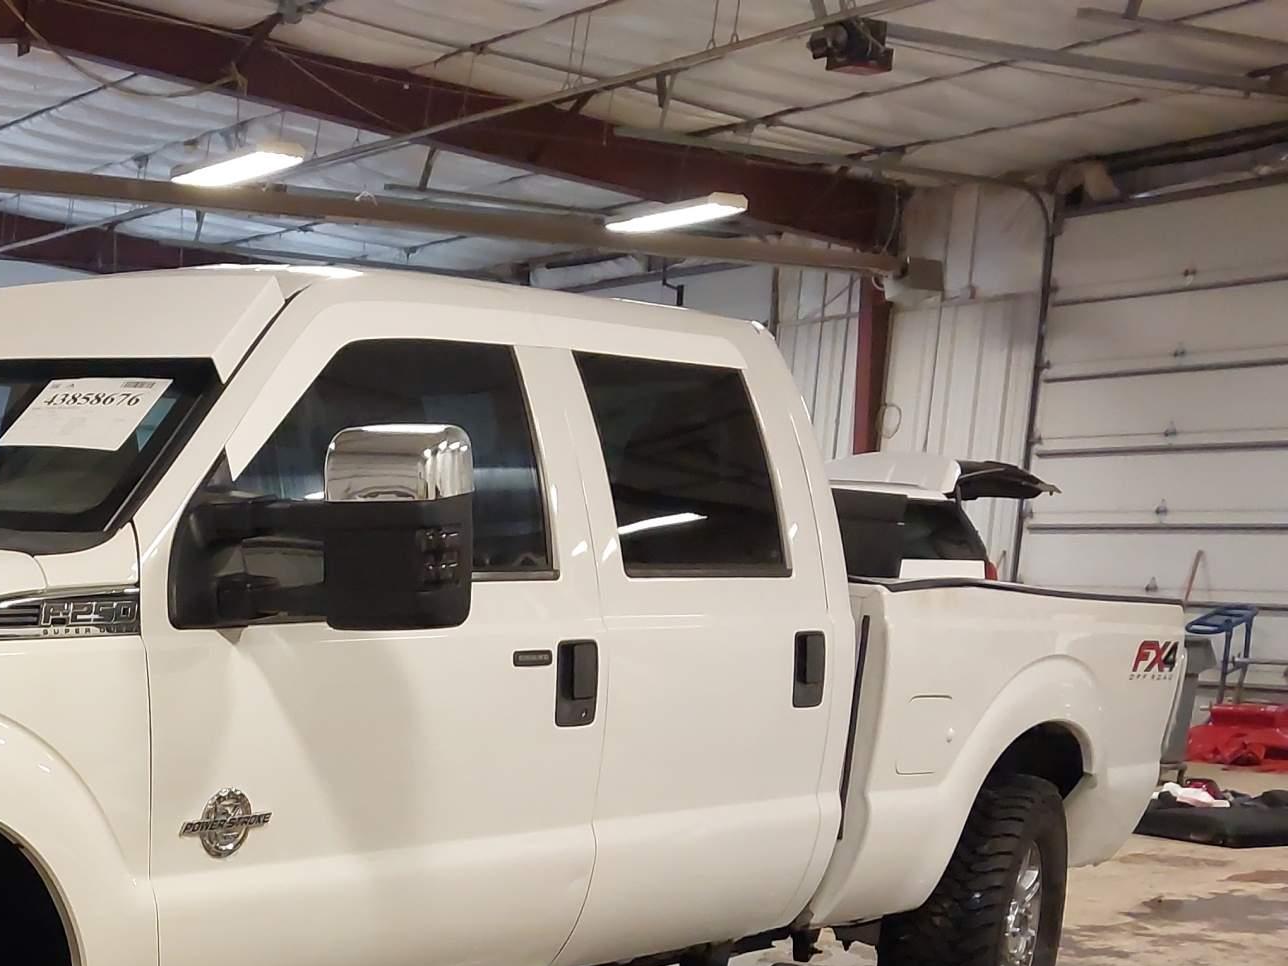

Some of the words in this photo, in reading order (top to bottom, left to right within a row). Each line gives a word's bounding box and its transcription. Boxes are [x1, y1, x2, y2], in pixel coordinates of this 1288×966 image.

[44, 392, 144, 407] 43858676
[42, 628, 91, 636] SUPER
[1132, 640, 1179, 672] FX4
